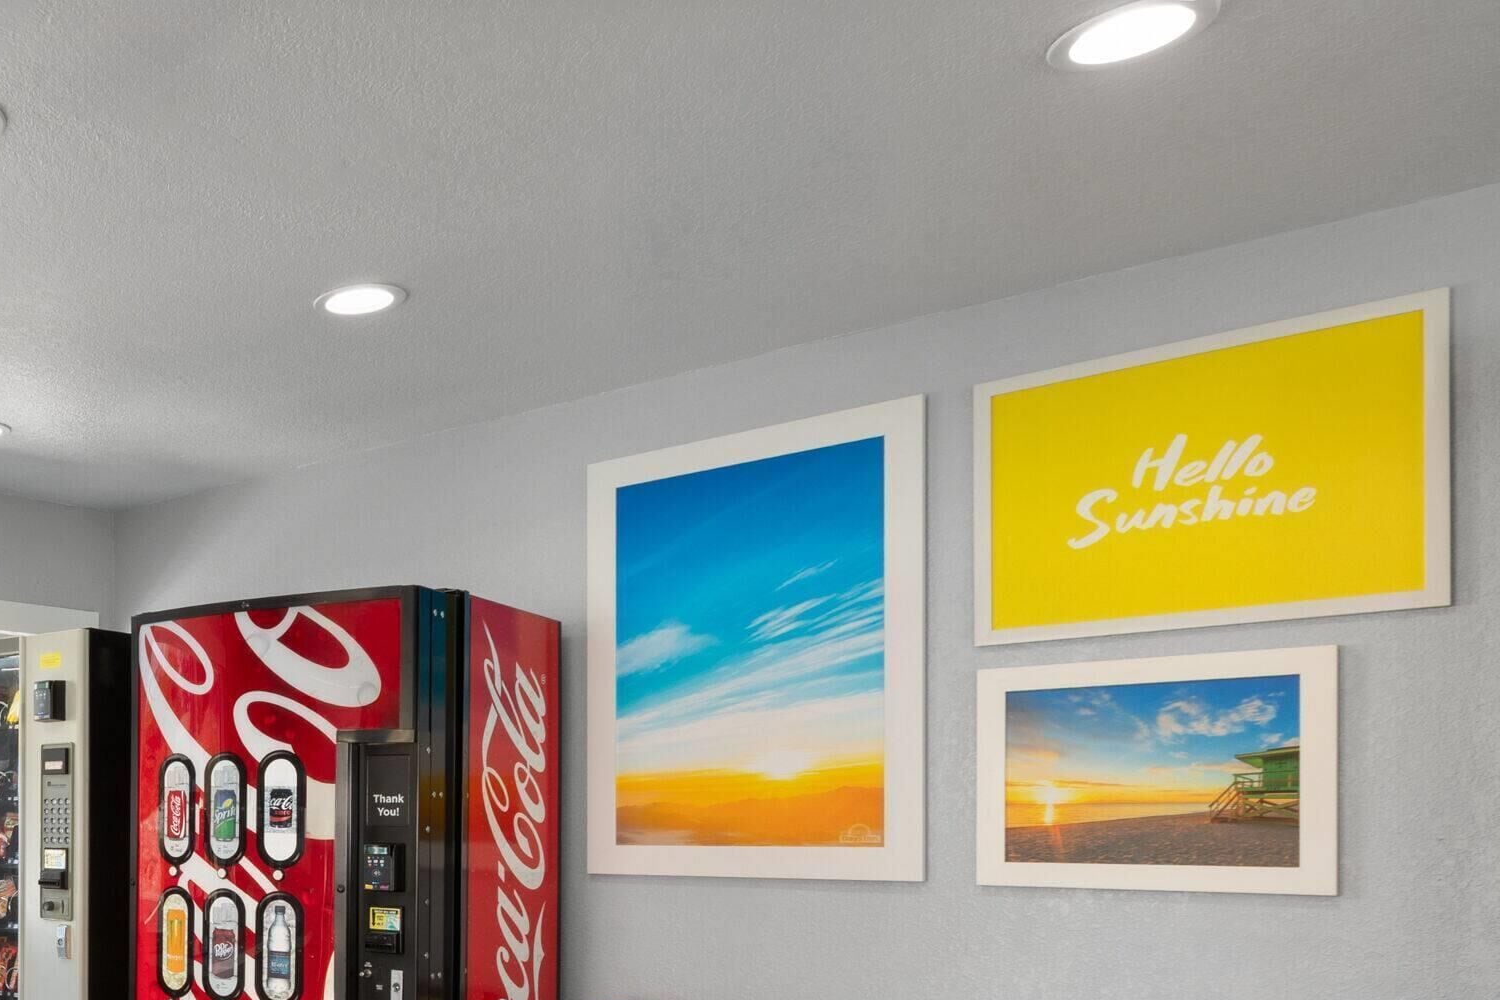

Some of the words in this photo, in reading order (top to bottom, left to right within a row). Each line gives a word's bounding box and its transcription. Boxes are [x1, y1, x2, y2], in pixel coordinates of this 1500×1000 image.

[1132, 433, 1274, 492] Hello
[1067, 485, 1317, 550] Sunshine
[373, 793, 404, 804] Thank
[377, 807, 400, 817] You!
